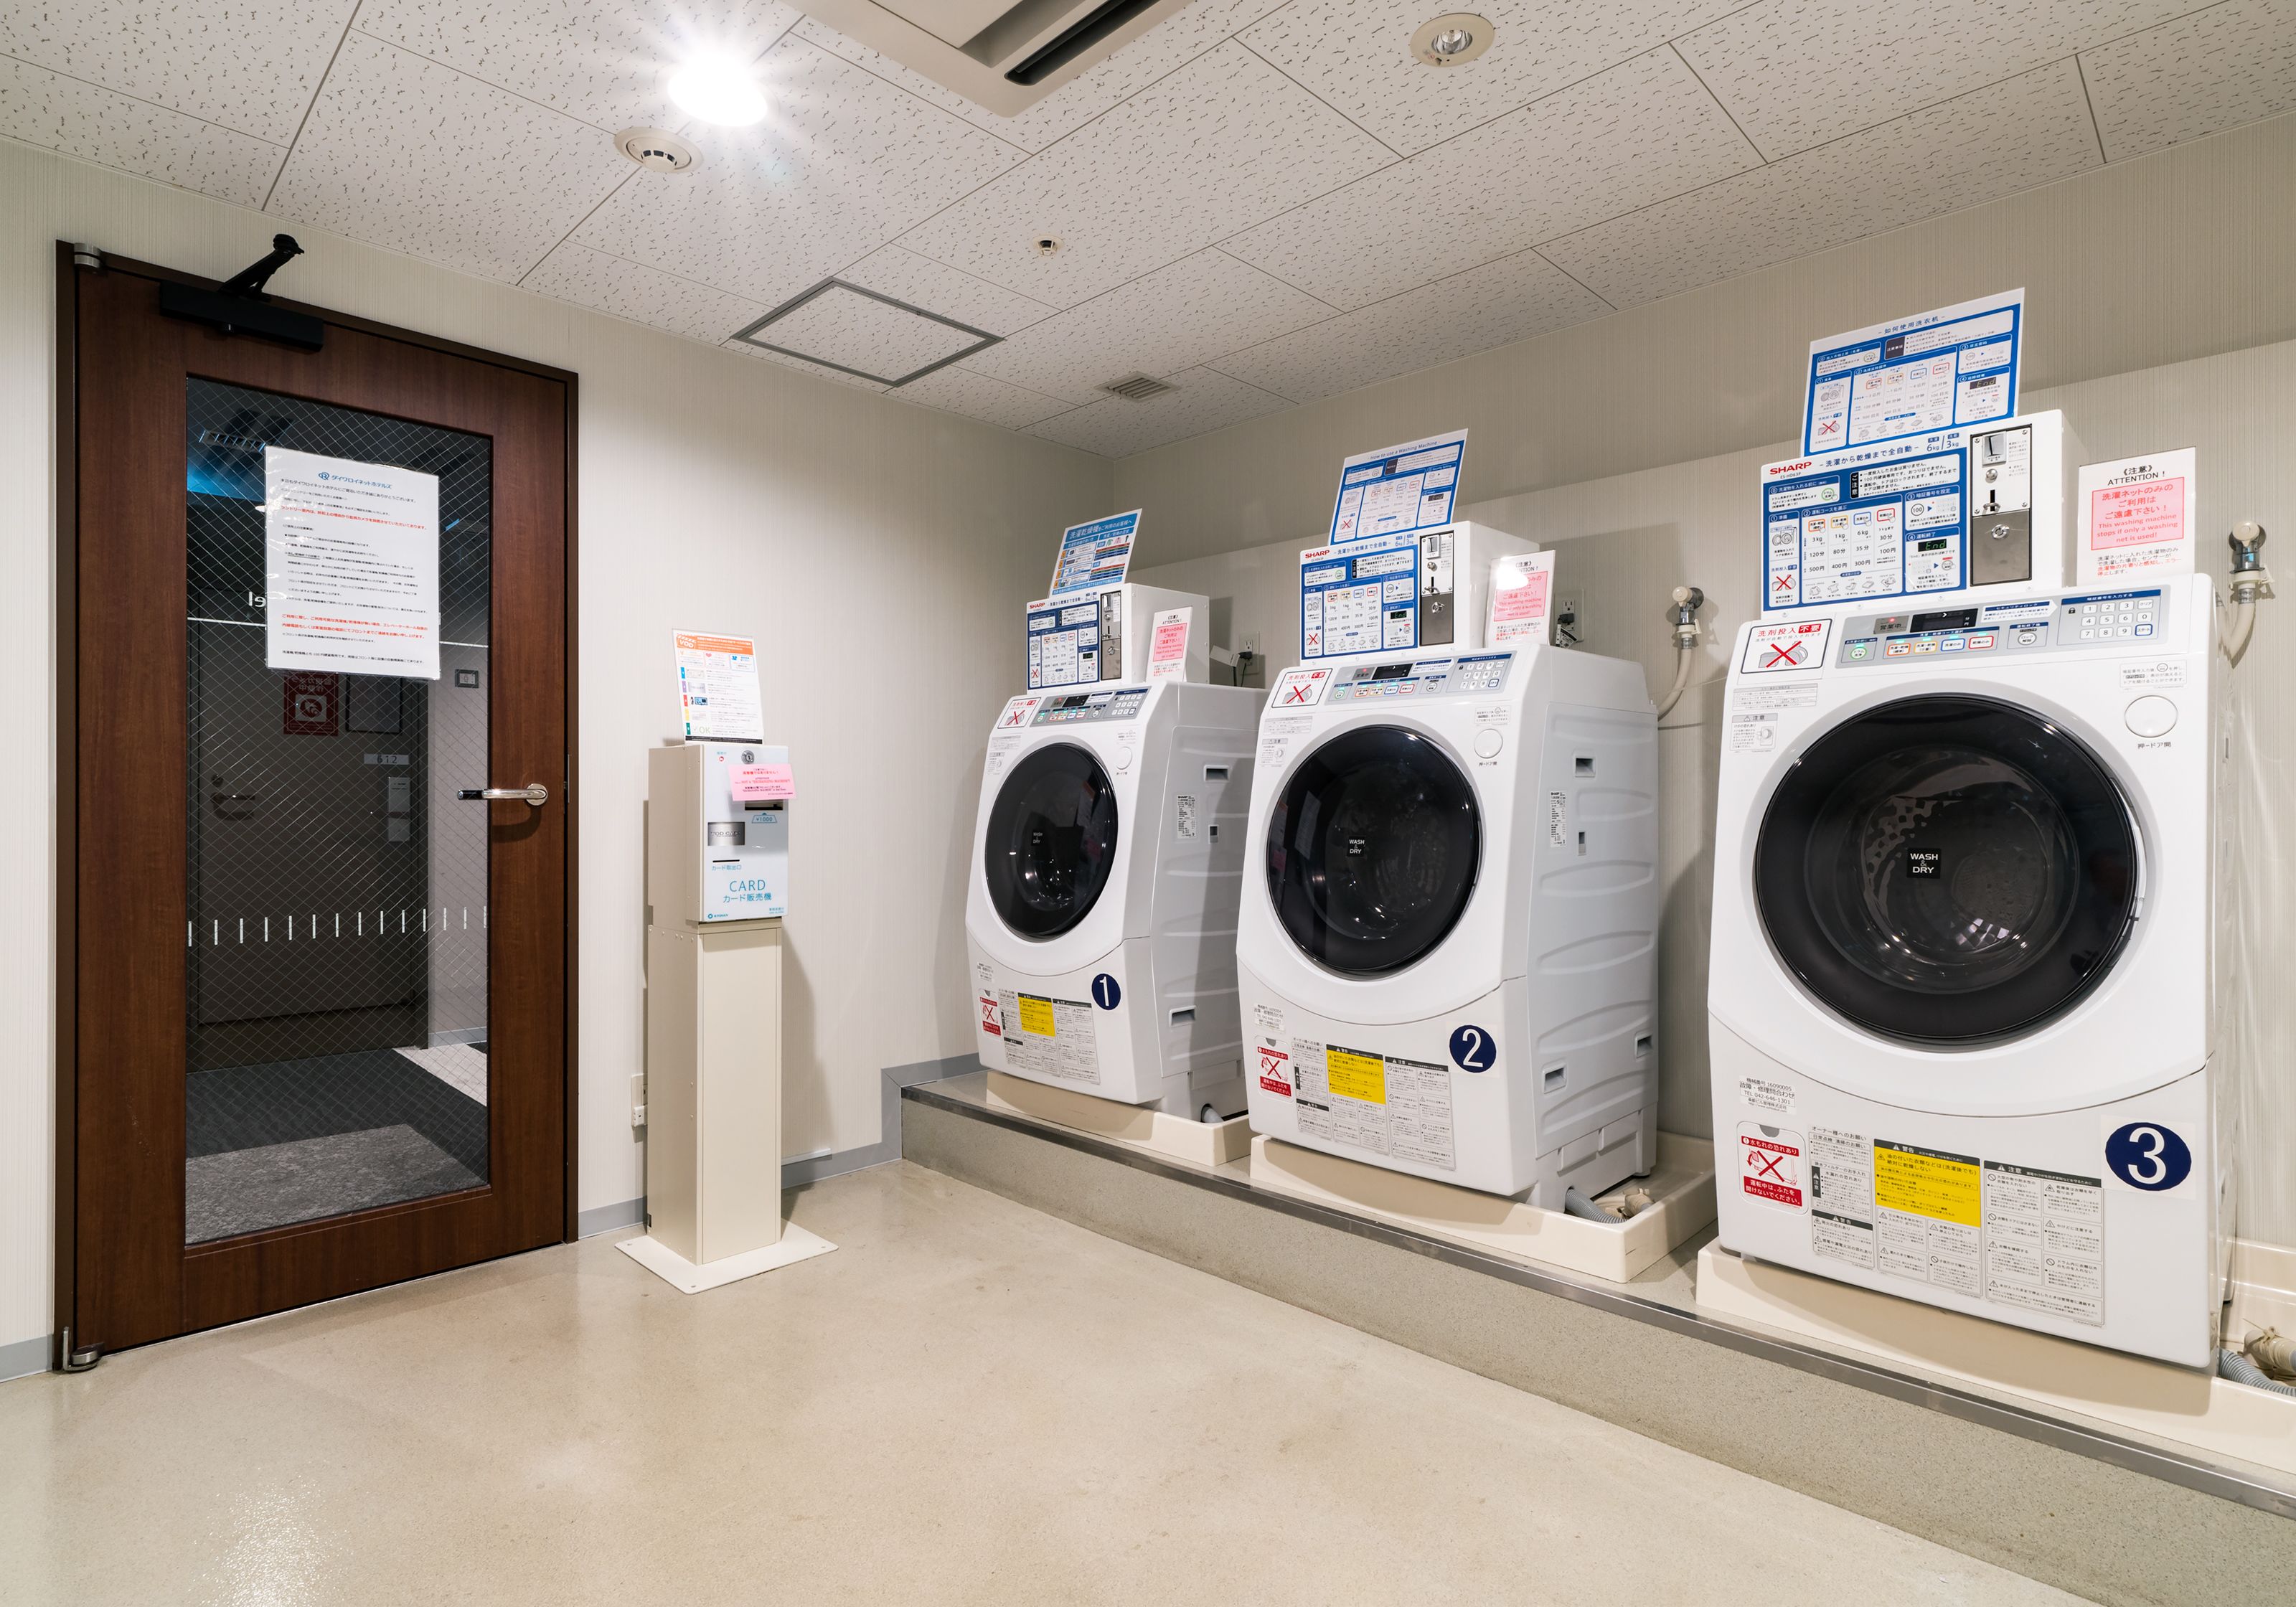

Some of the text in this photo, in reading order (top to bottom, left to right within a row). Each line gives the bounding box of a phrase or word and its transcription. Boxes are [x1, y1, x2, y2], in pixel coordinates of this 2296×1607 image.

[1884, 316, 1938, 334] 如何使用洗衣机
[1927, 443, 1939, 452] 6kg
[1946, 439, 1959, 449] 3kg
[1825, 446, 1912, 467] 洗濯から乾燥まで全自動
[1769, 461, 1812, 475] SHARP
[2123, 465, 2152, 476] 《注意》
[331, 475, 392, 489] ダイワロイネットホテルズ
[2108, 472, 2158, 486] ATTENTION
[1916, 489, 1950, 498] 暗証番号を設定
[2102, 484, 2173, 501] 洗濯ネットのみの
[2118, 496, 2157, 508] ご利用は
[1812, 505, 1847, 514] 運転コースを選ぶ
[2114, 518, 2144, 527] washing
[2145, 514, 2177, 522] machine
[2147, 522, 2178, 530] washing
[1337, 542, 1387, 555] 洗濯から乾燥まで全自動
[1925, 541, 1946, 550] End
[1305, 550, 1330, 559] SHARP
[2098, 547, 2178, 561] 洗濯ネットに入れた洗濯物のみ
[2099, 553, 2171, 566] で洗濯した場合、センサーが
[2086, 593, 2132, 601] 暗証番号を入力する
[1757, 624, 1820, 638] 洗剤投入 不要
[1755, 633, 1821, 643] 洗剤が自動で投入されます
[730, 880, 766, 892] CARD
[723, 892, 771, 903] カード販売機
[1099, 976, 1109, 1007] 1
[1462, 1029, 1483, 1068] 2
[1740, 1082, 1794, 1098] 故障・修理問合わせ
[1754, 1093, 1790, 1105] 042-646-1301
[1812, 1126, 1866, 1141] オーナー様へのお願い
[1749, 1139, 1797, 1155] 水もれの恐れあり
[2128, 1127, 2166, 1184] 3
[1887, 1160, 1931, 1172] 絶対に乾燥しない
[1826, 1172, 1862, 1182] 水漏れの恐れあり
[1750, 1179, 1795, 1195] 運転中は、ふたを
[2056, 1185, 2097, 1195] 乾燥後は衣類を早く
[1745, 1185, 1801, 1205] 開けないでください。
[2057, 1264, 2093, 1274] のものを入れない
